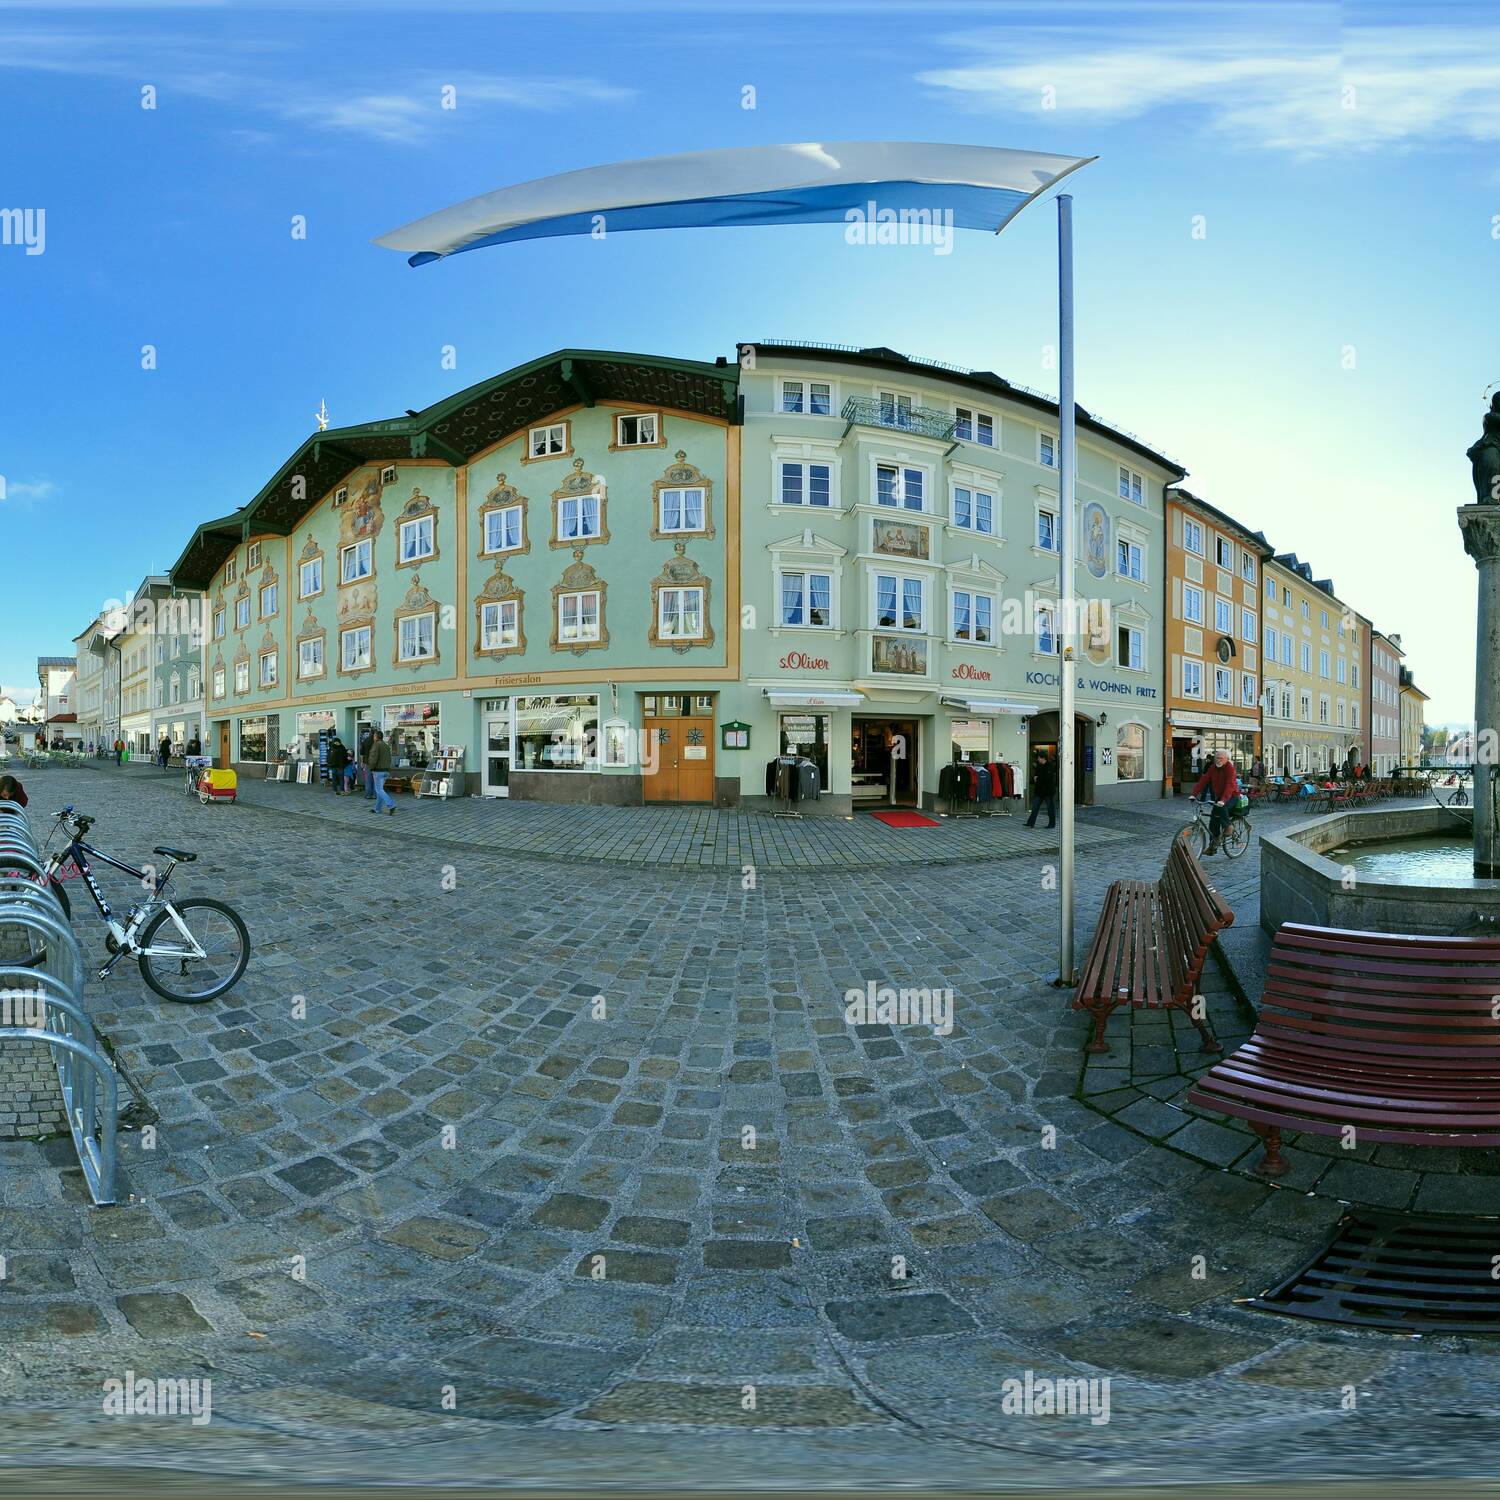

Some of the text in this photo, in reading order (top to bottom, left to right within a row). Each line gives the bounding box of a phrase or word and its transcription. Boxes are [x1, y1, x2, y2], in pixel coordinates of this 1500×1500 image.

[780, 651, 830, 670] s.Oliver
[495, 674, 541, 685] Frisiersalon
[952, 663, 991, 681] s.Oliver
[1026, 671, 1157, 699] KOCH & WOHNEN FRITZ
